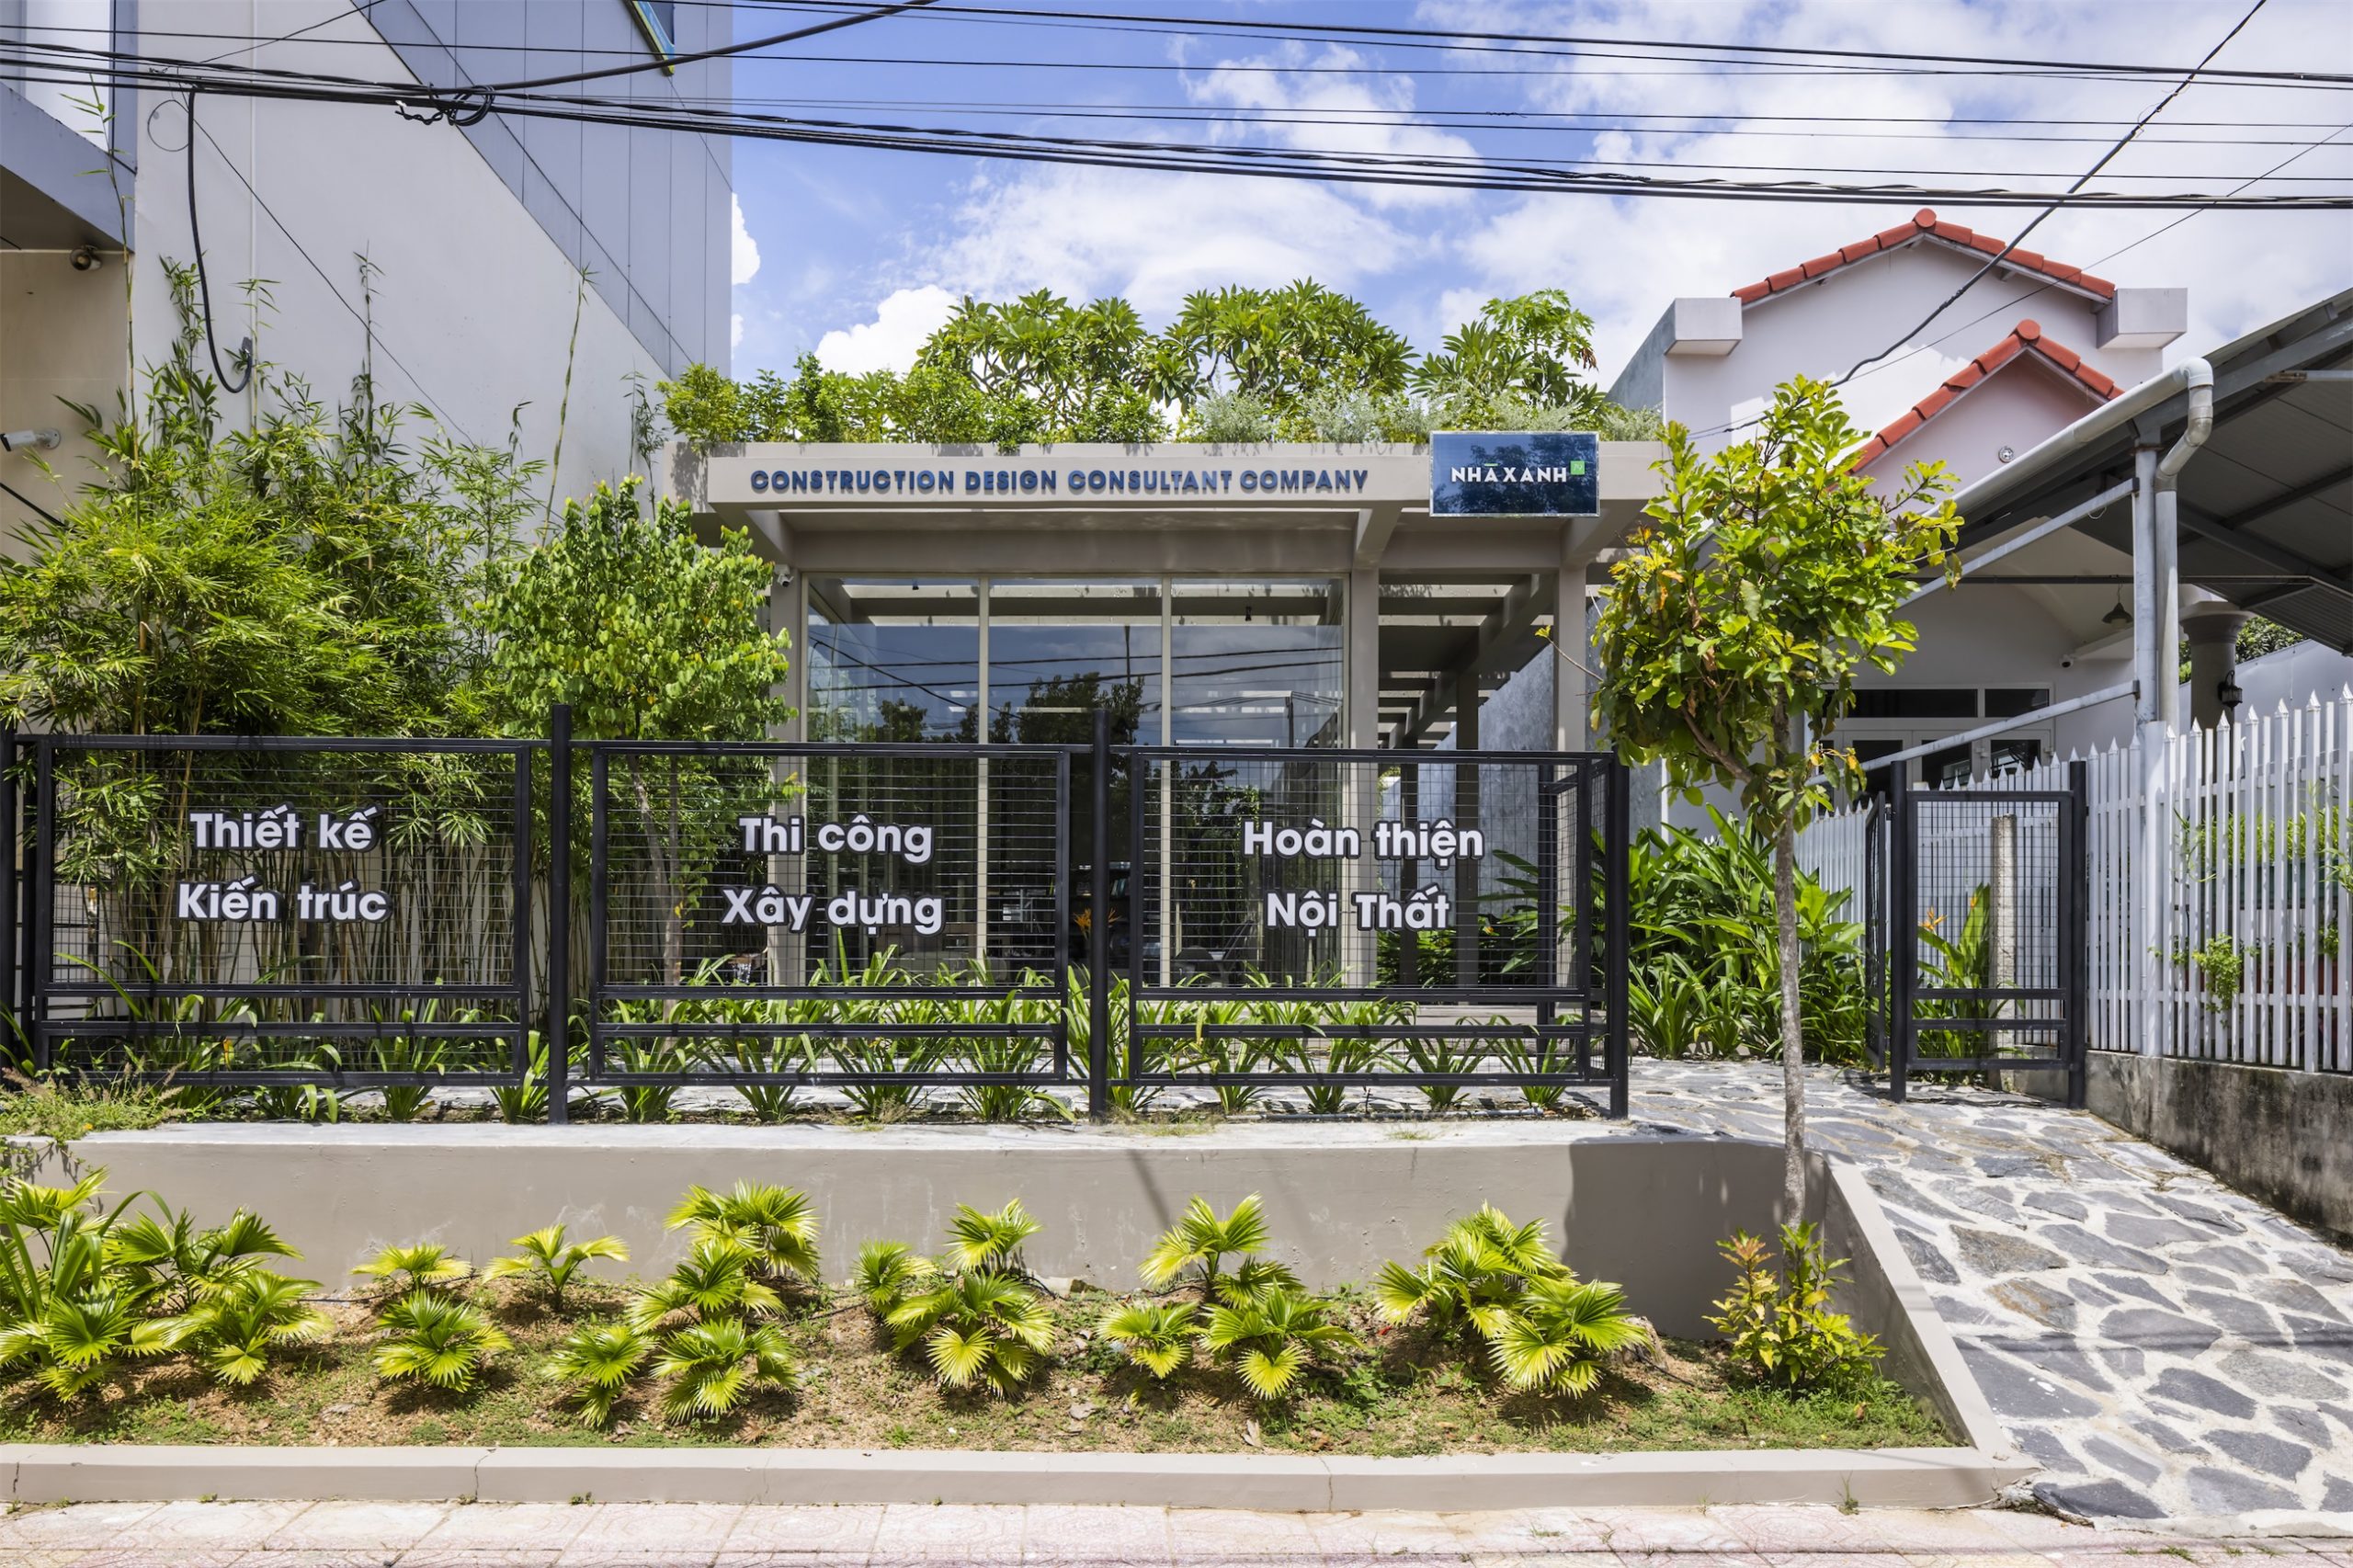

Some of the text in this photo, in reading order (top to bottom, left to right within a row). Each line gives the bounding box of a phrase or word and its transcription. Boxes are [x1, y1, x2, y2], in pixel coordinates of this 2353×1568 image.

[750, 470, 1369, 491] CONSTRUCTION DESIGN CONSULTANT COMPANY
[189, 803, 378, 850] Thiết kế
[738, 813, 933, 864] Thi công
[1244, 817, 1483, 867] Hoàn thiện
[177, 875, 387, 921] Kiến trúc
[721, 885, 943, 936] Xây dựng
[1267, 884, 1450, 937] Nội Thất
